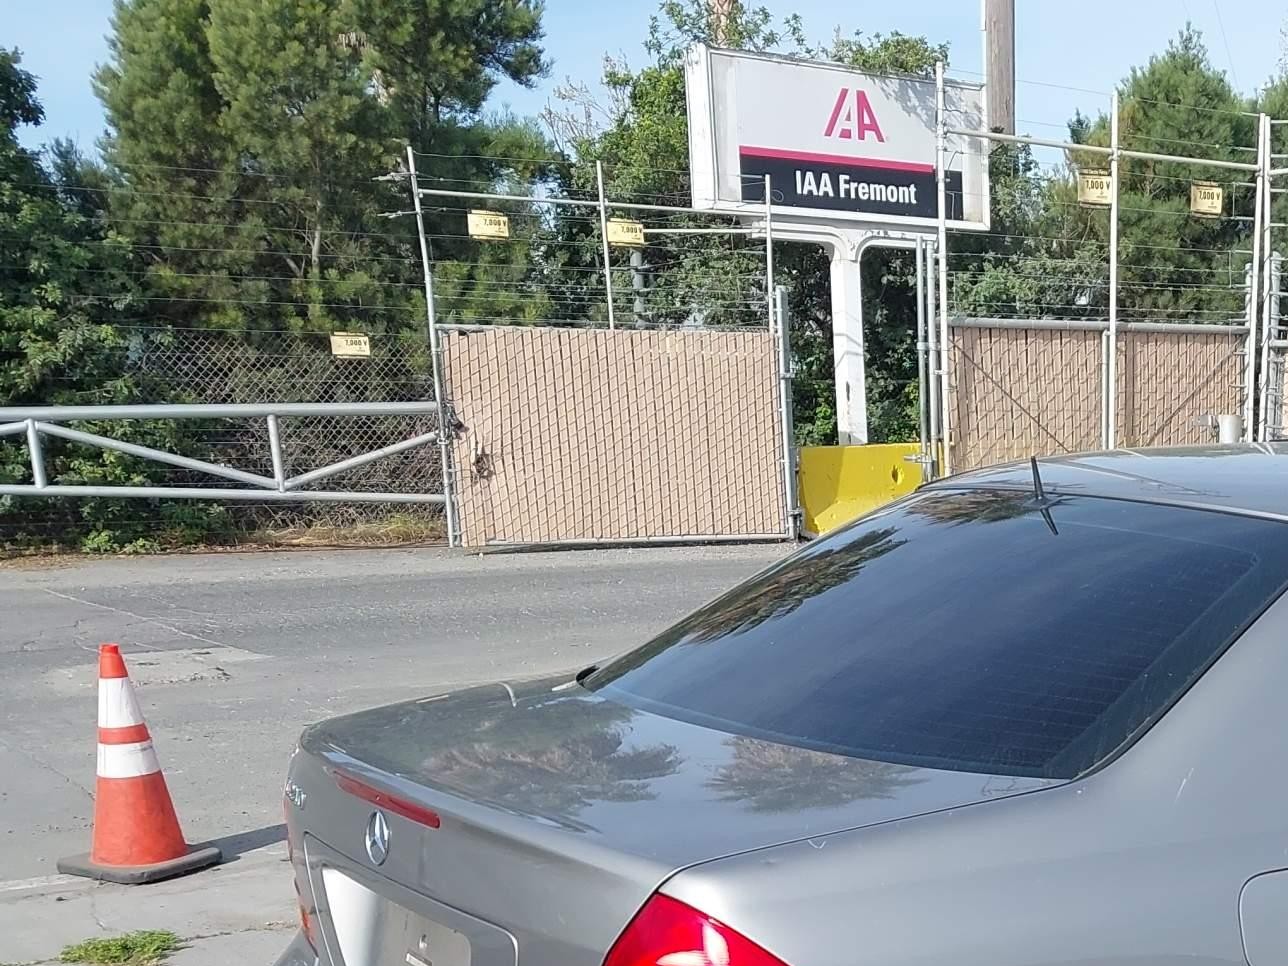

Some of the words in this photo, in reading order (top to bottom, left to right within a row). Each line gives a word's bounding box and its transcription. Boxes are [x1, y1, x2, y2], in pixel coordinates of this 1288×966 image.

[795, 169, 834, 198] IAA
[838, 173, 917, 205] Fremont
[1086, 180, 1104, 190] 7,000
[1199, 191, 1215, 200] 7,000
